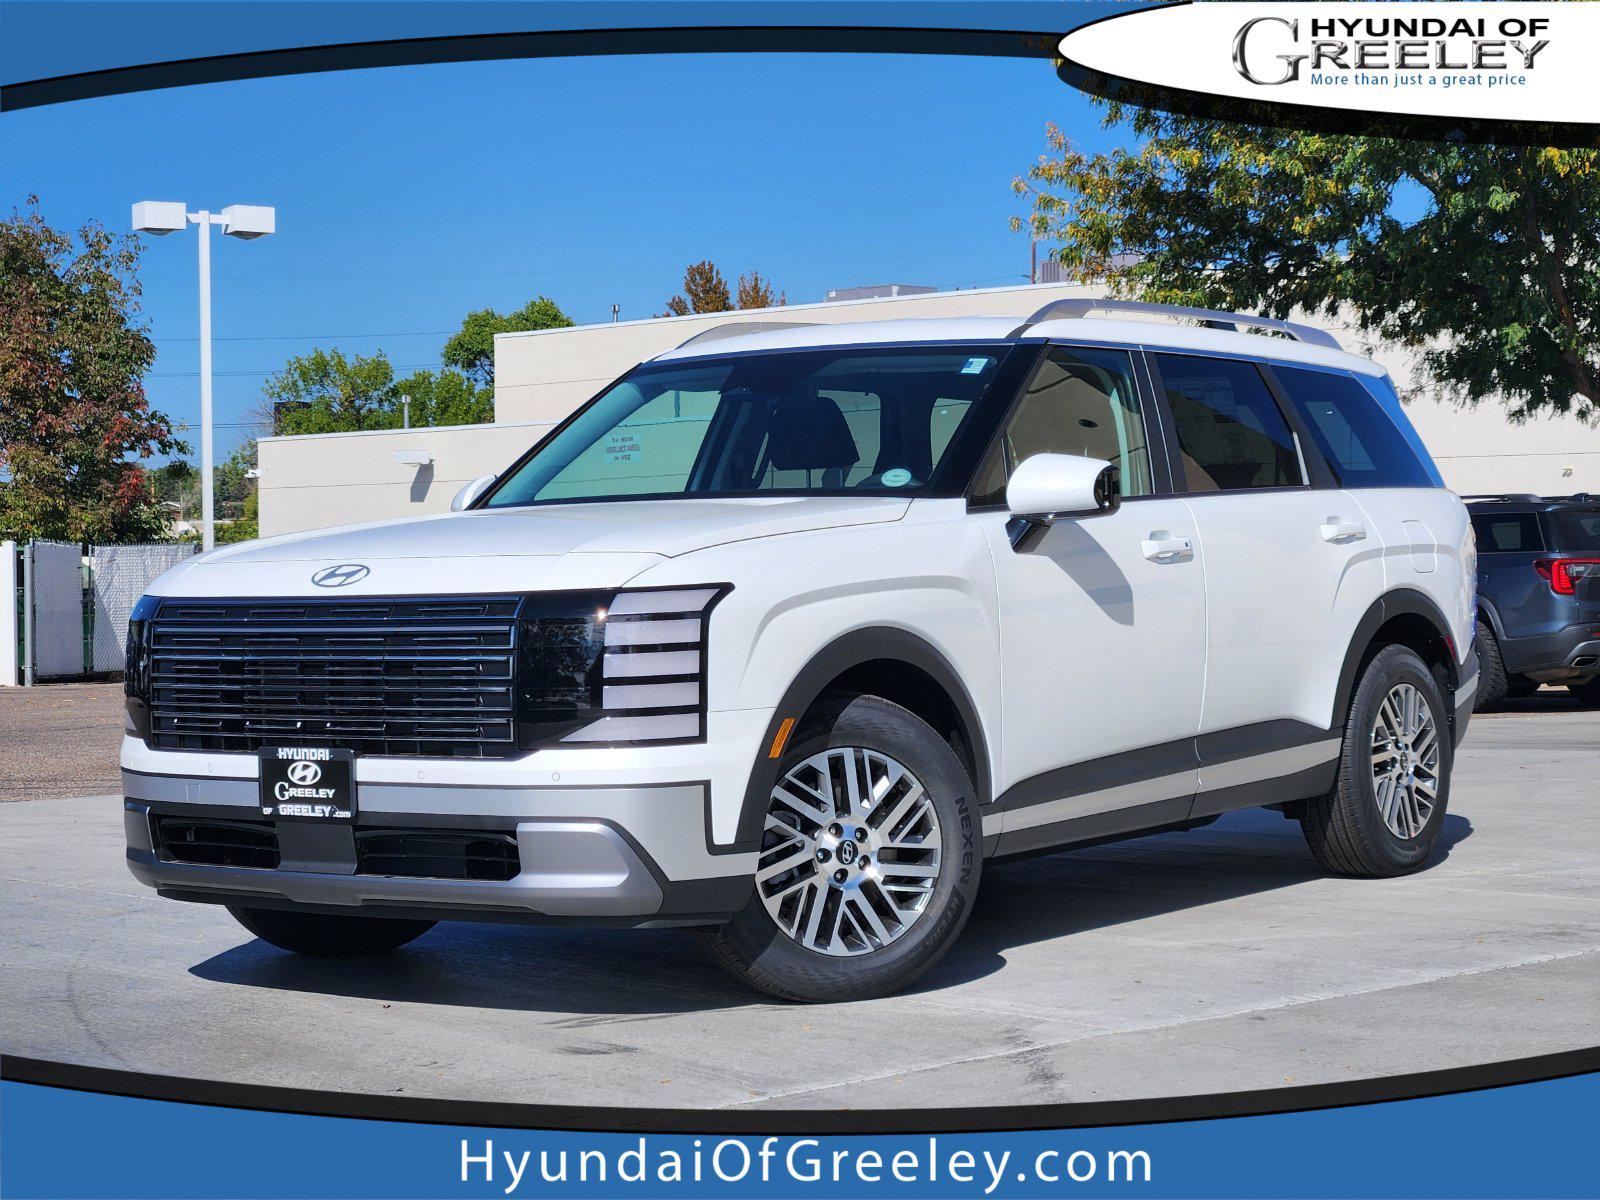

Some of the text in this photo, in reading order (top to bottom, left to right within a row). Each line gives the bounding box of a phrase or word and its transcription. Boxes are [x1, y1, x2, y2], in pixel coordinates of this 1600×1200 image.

[278, 747, 330, 761] HYUNDAI
[274, 781, 336, 801] GREELEY
[279, 804, 331, 817] GREELEY
[955, 796, 974, 885] NEXEN
